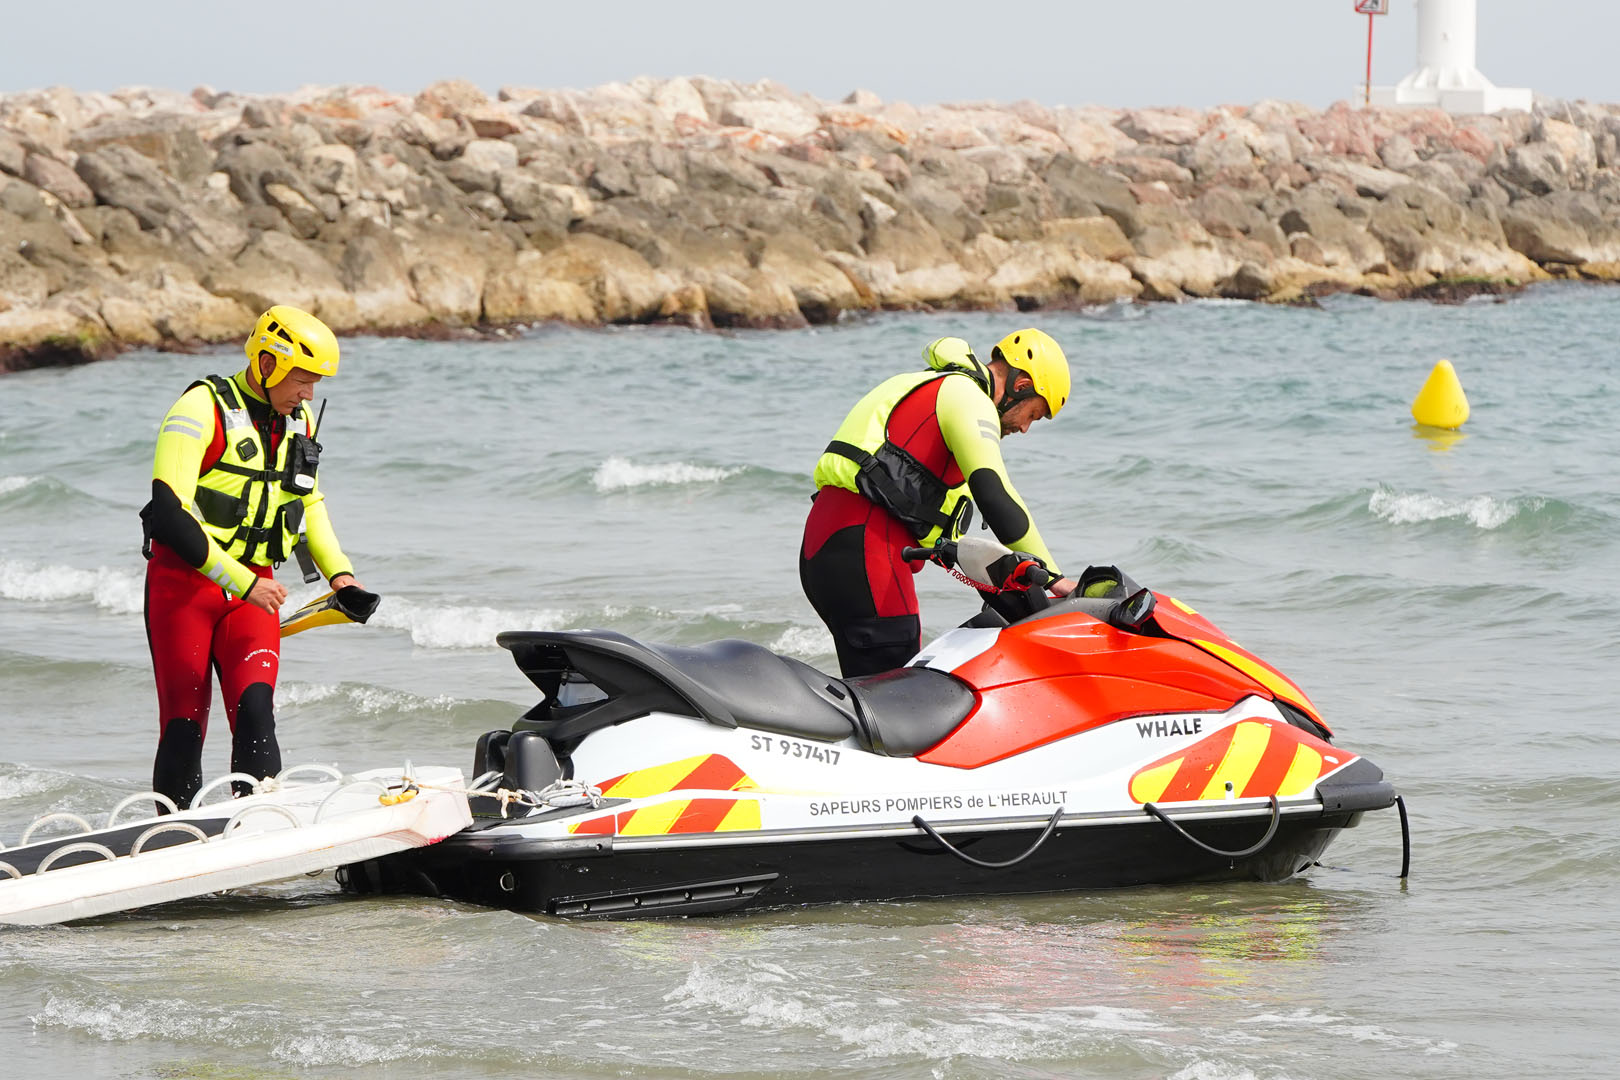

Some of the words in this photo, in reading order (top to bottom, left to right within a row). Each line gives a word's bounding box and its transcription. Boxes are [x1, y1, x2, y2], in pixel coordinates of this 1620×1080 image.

[1136, 718, 1202, 738] WHALE
[751, 735, 772, 752] ST
[780, 740, 841, 765] 937417
[809, 799, 881, 816] SAPEURS
[886, 796, 963, 812] POMPIERS
[967, 797, 983, 808] de
[988, 791, 1067, 807] L'HERAULT
